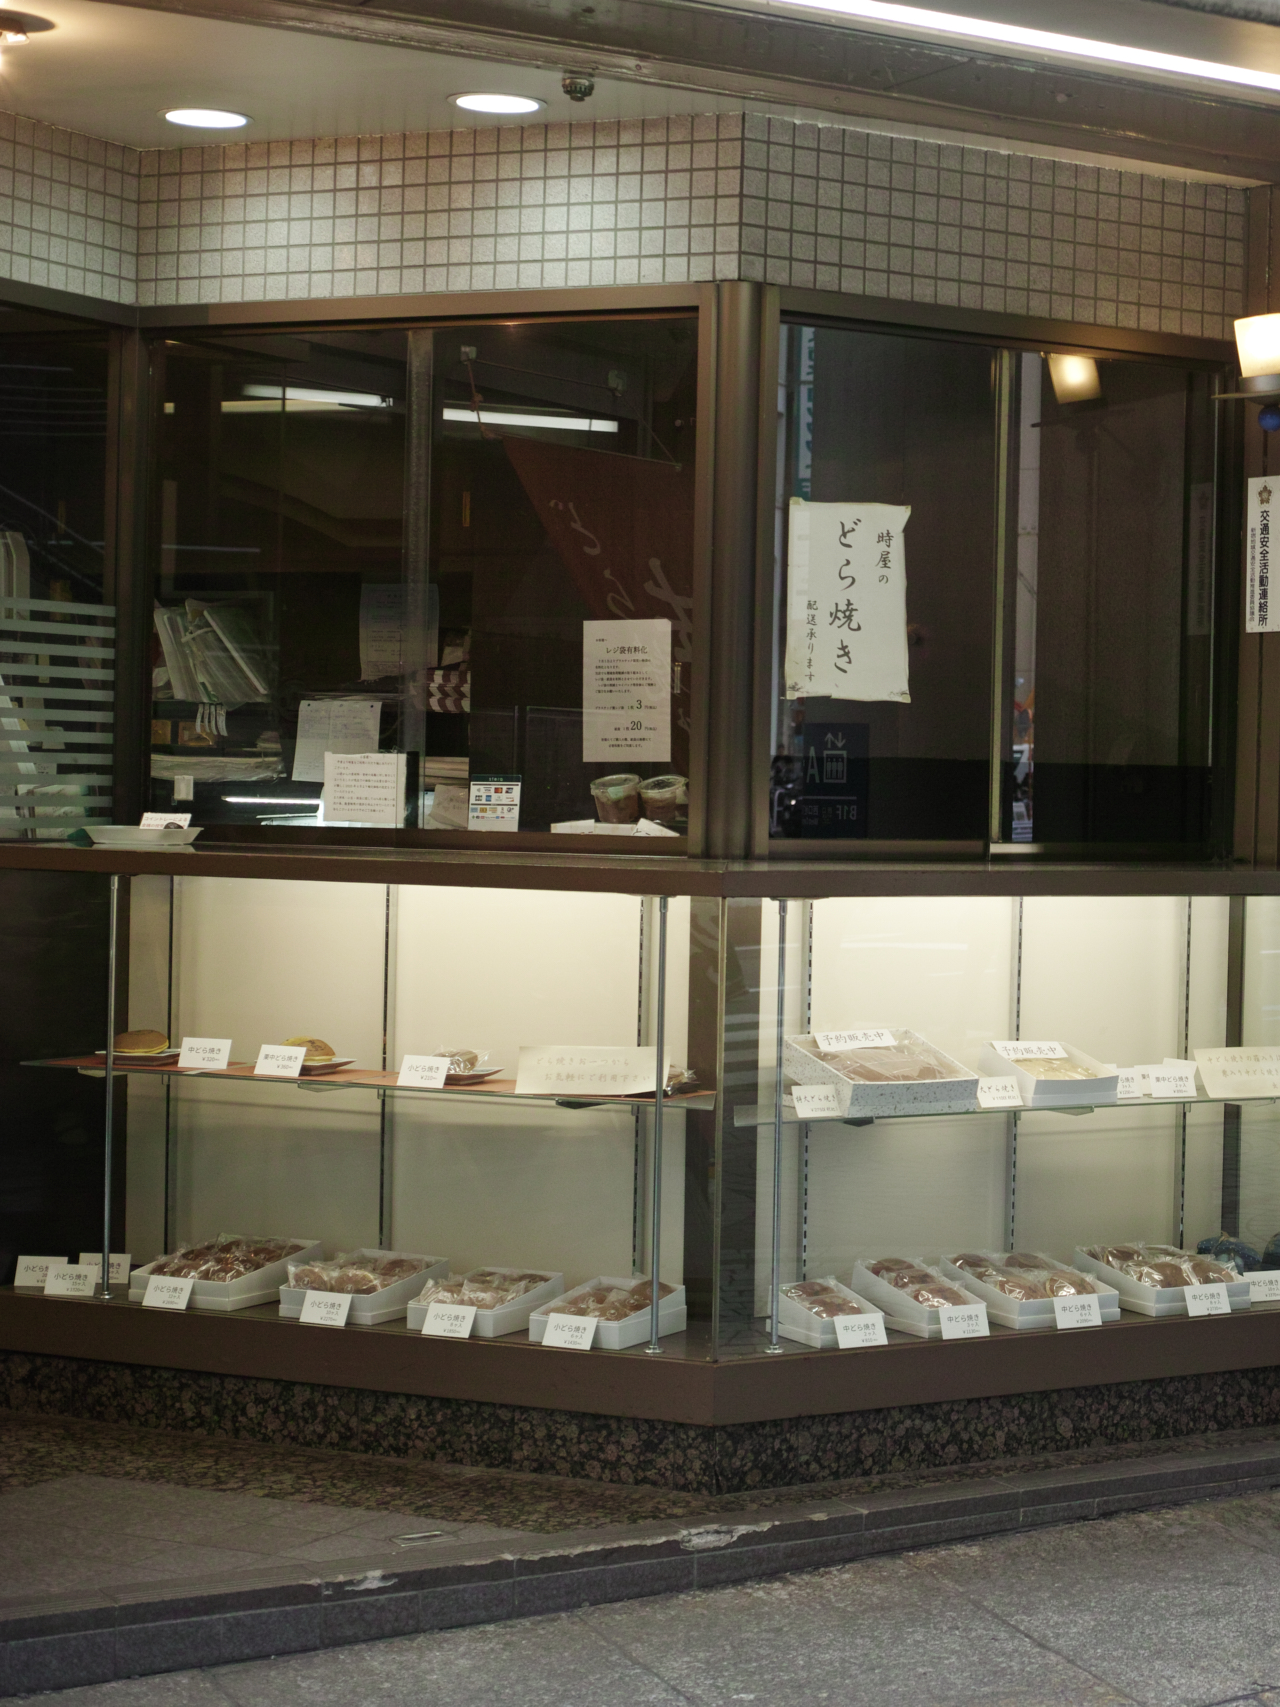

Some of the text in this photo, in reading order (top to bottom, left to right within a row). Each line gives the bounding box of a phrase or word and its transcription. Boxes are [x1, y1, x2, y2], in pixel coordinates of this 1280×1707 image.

[876, 529, 894, 584] 時屋の
[1258, 510, 1270, 626] 交通安全活動連絡所
[829, 518, 862, 674] どら焼き
[804, 600, 818, 682] 配送承ります
[606, 646, 648, 654] レジ袋有料化
[630, 720, 642, 731] 20
[822, 1031, 885, 1045] 予約販売中
[188, 1046, 221, 1054] 中どら焼き
[537, 1056, 629, 1066] どら焼きお一つから
[407, 1064, 440, 1073] 小どら焼き
[980, 1085, 1015, 1093] 大どら焼き
[54, 1272, 88, 1281] 小どら焼き
[1251, 1279, 1279, 1287] 中どら焼き
[153, 1285, 184, 1294] 小どら焼き
[1191, 1292, 1221, 1301] 中どら焼き
[310, 1300, 341, 1310] 小どら焼き
[1061, 1303, 1092, 1312] 中どら焼き
[433, 1313, 466, 1323] 小どら焼き
[946, 1314, 979, 1323] 中どら焼き
[554, 1323, 587, 1333] 小どら焼き
[843, 1323, 876, 1332] 中どら焼き
